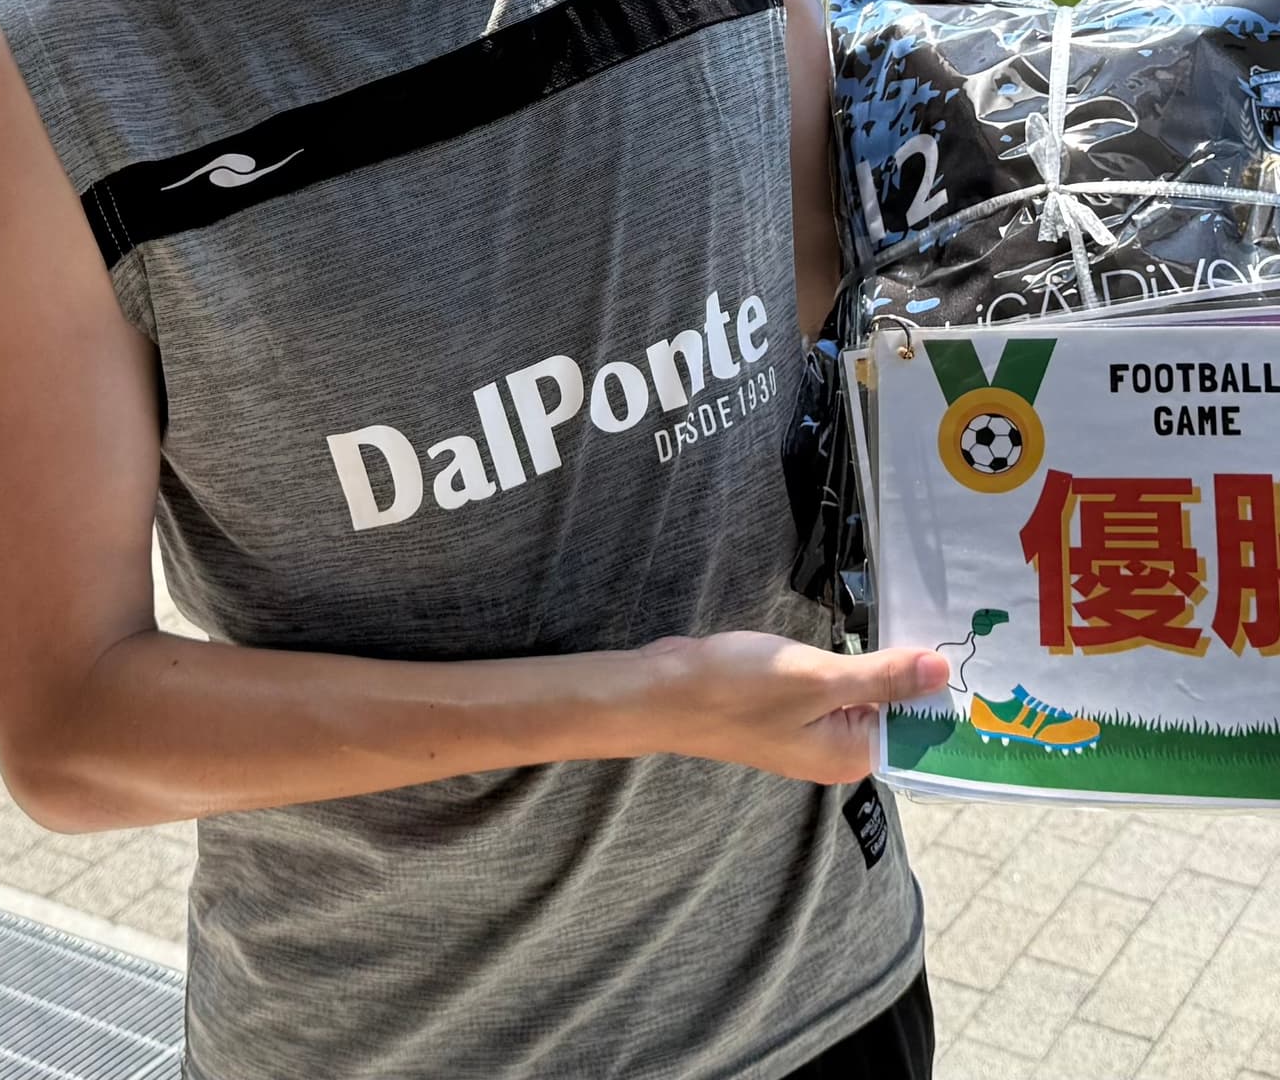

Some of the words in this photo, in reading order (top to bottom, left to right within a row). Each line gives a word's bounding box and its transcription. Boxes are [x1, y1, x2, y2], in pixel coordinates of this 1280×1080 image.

[325, 293, 772, 531] DalPonte
[737, 366, 777, 417] 1930
[1153, 404, 1242, 437] GAME
